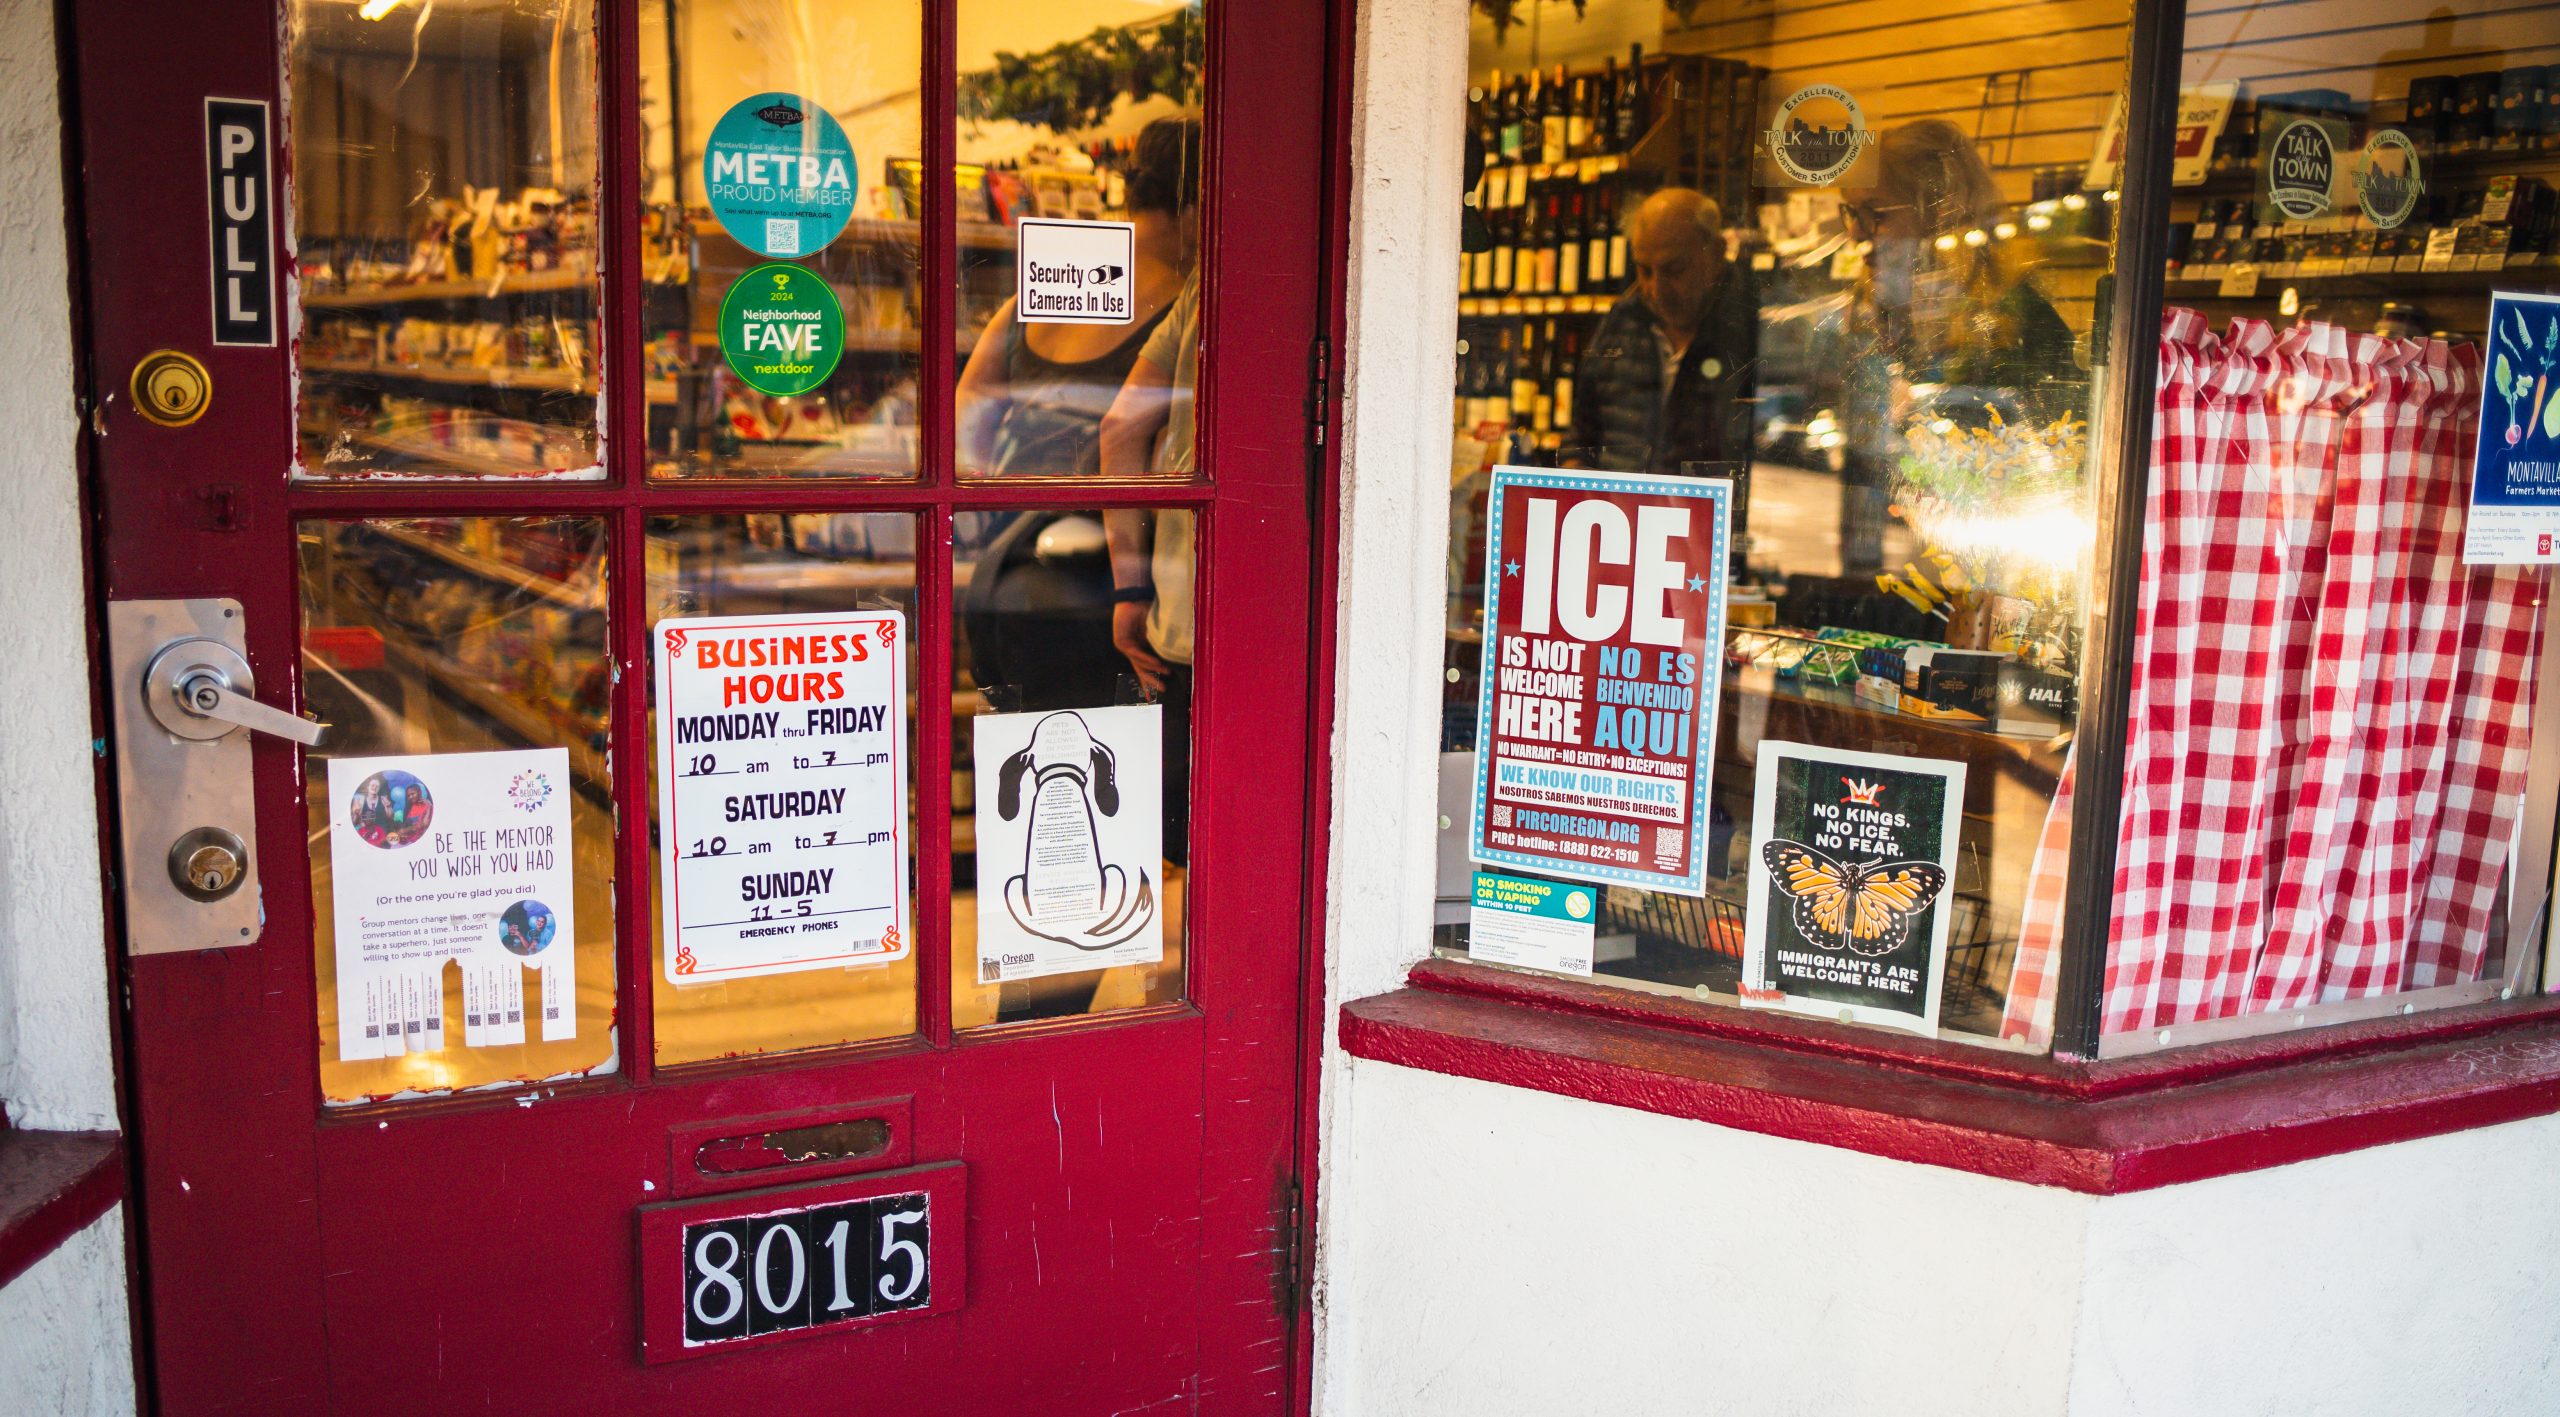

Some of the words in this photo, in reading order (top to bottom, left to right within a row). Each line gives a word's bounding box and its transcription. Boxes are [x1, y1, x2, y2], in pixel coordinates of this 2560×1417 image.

[1784, 88, 1846, 111] EXCELLENCE
[763, 110, 800, 121] METBA
[715, 141, 748, 149] Montavilla
[1763, 130, 1802, 146] TALK
[1826, 130, 1876, 146] TOWN
[2287, 134, 2324, 158] TALK
[1776, 146, 1808, 181] CUSTOMER
[1810, 145, 1860, 182] SATISFACTION
[1800, 152, 1831, 161] 2011
[712, 151, 850, 189] METBA
[2278, 158, 2328, 183] TOWN
[712, 183, 776, 202] PROUD
[780, 188, 852, 206] MEMBER
[2351, 171, 2378, 190] TALK
[2395, 176, 2426, 195] TOWN
[220, 124, 257, 322] PULL
[795, 211, 832, 219] METBA.ORG
[1029, 261, 1084, 289] Security
[770, 292, 794, 301] 2024
[1029, 289, 1083, 311] Cameras
[1087, 291, 1098, 312] In
[1102, 292, 1124, 313] Use
[743, 309, 822, 322] Neighborhood
[743, 323, 822, 351] FAVE
[753, 362, 815, 374] nextdoor
[2505, 485, 2535, 495] Farmers
[1521, 497, 1691, 647] ICE
[1502, 635, 1528, 668] IS
[1531, 638, 1586, 673] NOT
[1599, 645, 1642, 679] NO
[1658, 651, 1696, 685] ES
[723, 671, 845, 709] HOURS
[1500, 667, 1584, 700] WELCOME
[1596, 677, 1694, 711] BIENVENIDO
[677, 711, 780, 745] MONDAY
[782, 727, 805, 738] thru
[807, 704, 887, 736] FRIDAY
[1498, 693, 1582, 745] HERE
[1593, 703, 1692, 758] AQUÍ
[689, 753, 717, 776] 10
[746, 760, 770, 774] am
[793, 756, 810, 770] to
[822, 750, 837, 767] 7
[866, 752, 889, 768] pm
[1497, 740, 1511, 756] NO
[1625, 756, 1688, 778] EXCEPTIONS!
[519, 788, 542, 798] BELONG
[526, 780, 535, 788] WE
[1501, 763, 1525, 784] WE
[1528, 766, 1578, 790] KNOW
[1580, 774, 1613, 795] OUR
[1617, 778, 1680, 804] RIGHTS.
[724, 787, 847, 823] SATURDAY
[1499, 785, 1543, 800] NOSOTROS
[1544, 790, 1585, 806] SABEMOS
[1586, 796, 1631, 812] NUESTROS
[1632, 803, 1680, 819] DERECHOS.
[1515, 808, 1640, 845] PIRCOREGON.ORG
[1813, 803, 1840, 818] NO
[1846, 807, 1911, 828] KINGS.
[435, 832, 454, 854] BE
[463, 830, 488, 852] THE
[496, 825, 554, 850] MENTOR
[822, 830, 838, 846] 7
[867, 830, 890, 846] pm
[1826, 819, 1853, 836] NO
[1859, 824, 1895, 841] ICE.
[692, 835, 728, 858] 10
[748, 841, 772, 854] am
[794, 835, 811, 850] to
[1491, 830, 1516, 846] PIRC
[1516, 833, 1558, 852] hotline:
[1559, 840, 1589, 856] (888)
[1590, 844, 1640, 864] 622-1510
[1815, 833, 1842, 849] NO
[1849, 837, 1904, 857] FEAR.
[409, 857, 437, 881] YOU
[446, 854, 481, 878] WISH
[490, 852, 518, 875] YOU
[526, 849, 554, 872] HAD
[376, 895, 393, 906] (Or
[395, 894, 413, 904] the
[415, 893, 435, 902] one
[436, 891, 468, 904] you're
[470, 887, 492, 901] glad
[494, 887, 513, 898] you
[515, 884, 537, 894] did)
[741, 868, 834, 902] SUNDAY
[1477, 876, 1495, 889] NO
[1497, 879, 1552, 897] SMOKING
[1477, 887, 1493, 899] OR
[1495, 890, 1541, 906] VAPING
[750, 904, 774, 922] 11
[797, 899, 813, 917] 5
[1476, 898, 1504, 909] WITHIN
[1504, 902, 1512, 910] 10
[1514, 904, 1533, 913] FEET
[361, 920, 386, 930] Group
[387, 917, 419, 928] mentors
[420, 914, 448, 926] change
[472, 911, 487, 920] one
[362, 929, 412, 940] conversation
[413, 928, 422, 936] at
[423, 927, 429, 935] a
[461, 922, 488, 932] doesn't
[739, 925, 796, 939] EMERGENCY
[802, 920, 839, 933] PHONES
[363, 942, 380, 951] take
[389, 938, 431, 950] superhero,
[449, 934, 483, 943] someone
[363, 952, 390, 963] willing
[391, 952, 400, 960] to
[401, 950, 421, 959] show
[422, 949, 433, 959] up
[434, 947, 449, 956] and
[450, 945, 475, 955] listen.
[1002, 952, 1035, 965] Oregon
[1559, 960, 1588, 971] oregon
[1777, 949, 1882, 975] IMMIGRANTS
[1886, 965, 1919, 982] ARE
[1781, 963, 1862, 985] WELCOME
[1867, 975, 1914, 994] HERE.
[692, 1210, 926, 1326] 8015
